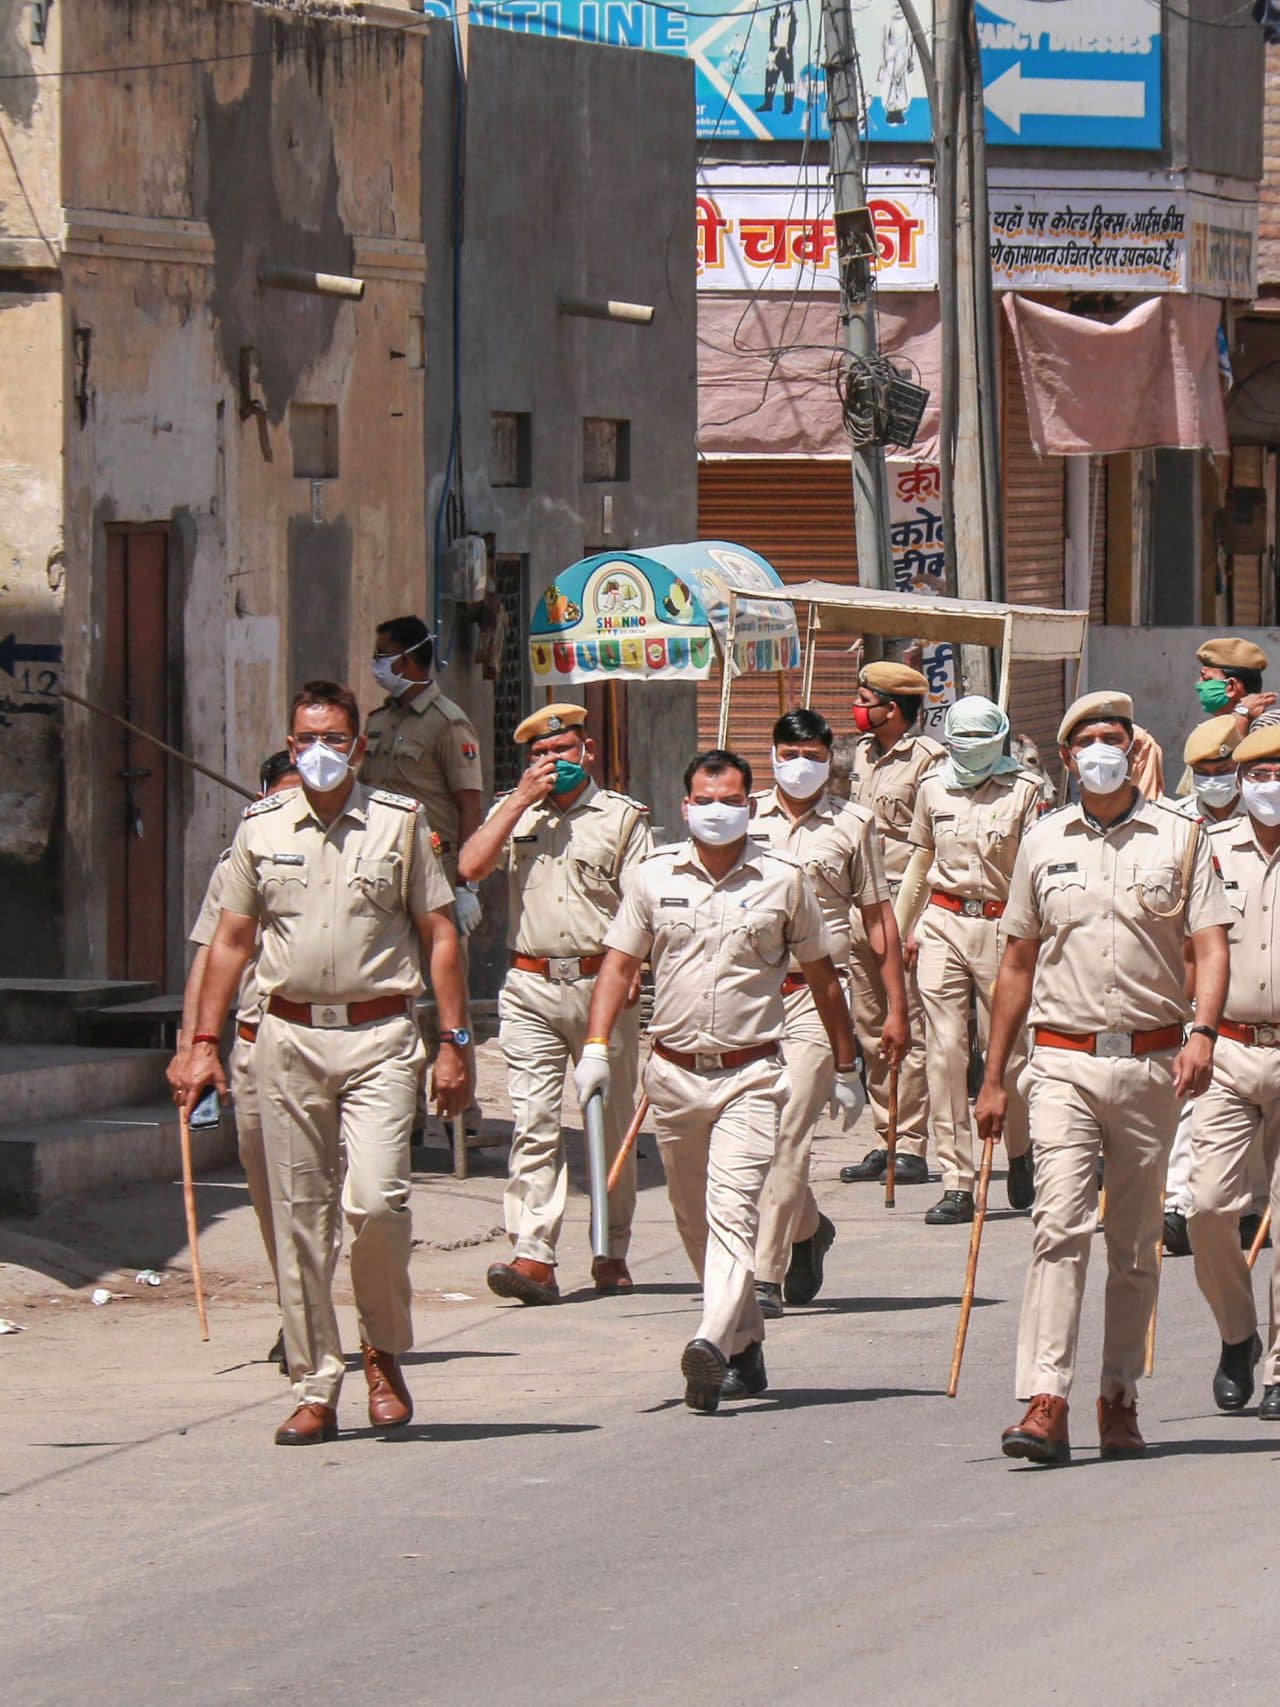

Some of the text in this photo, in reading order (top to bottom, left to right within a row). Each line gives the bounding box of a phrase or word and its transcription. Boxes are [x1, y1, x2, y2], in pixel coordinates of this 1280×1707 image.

[1027, 211, 1049, 232] पर
[1050, 204, 1089, 234] कोल्ड
[596, 615, 647, 629] SHANNO
